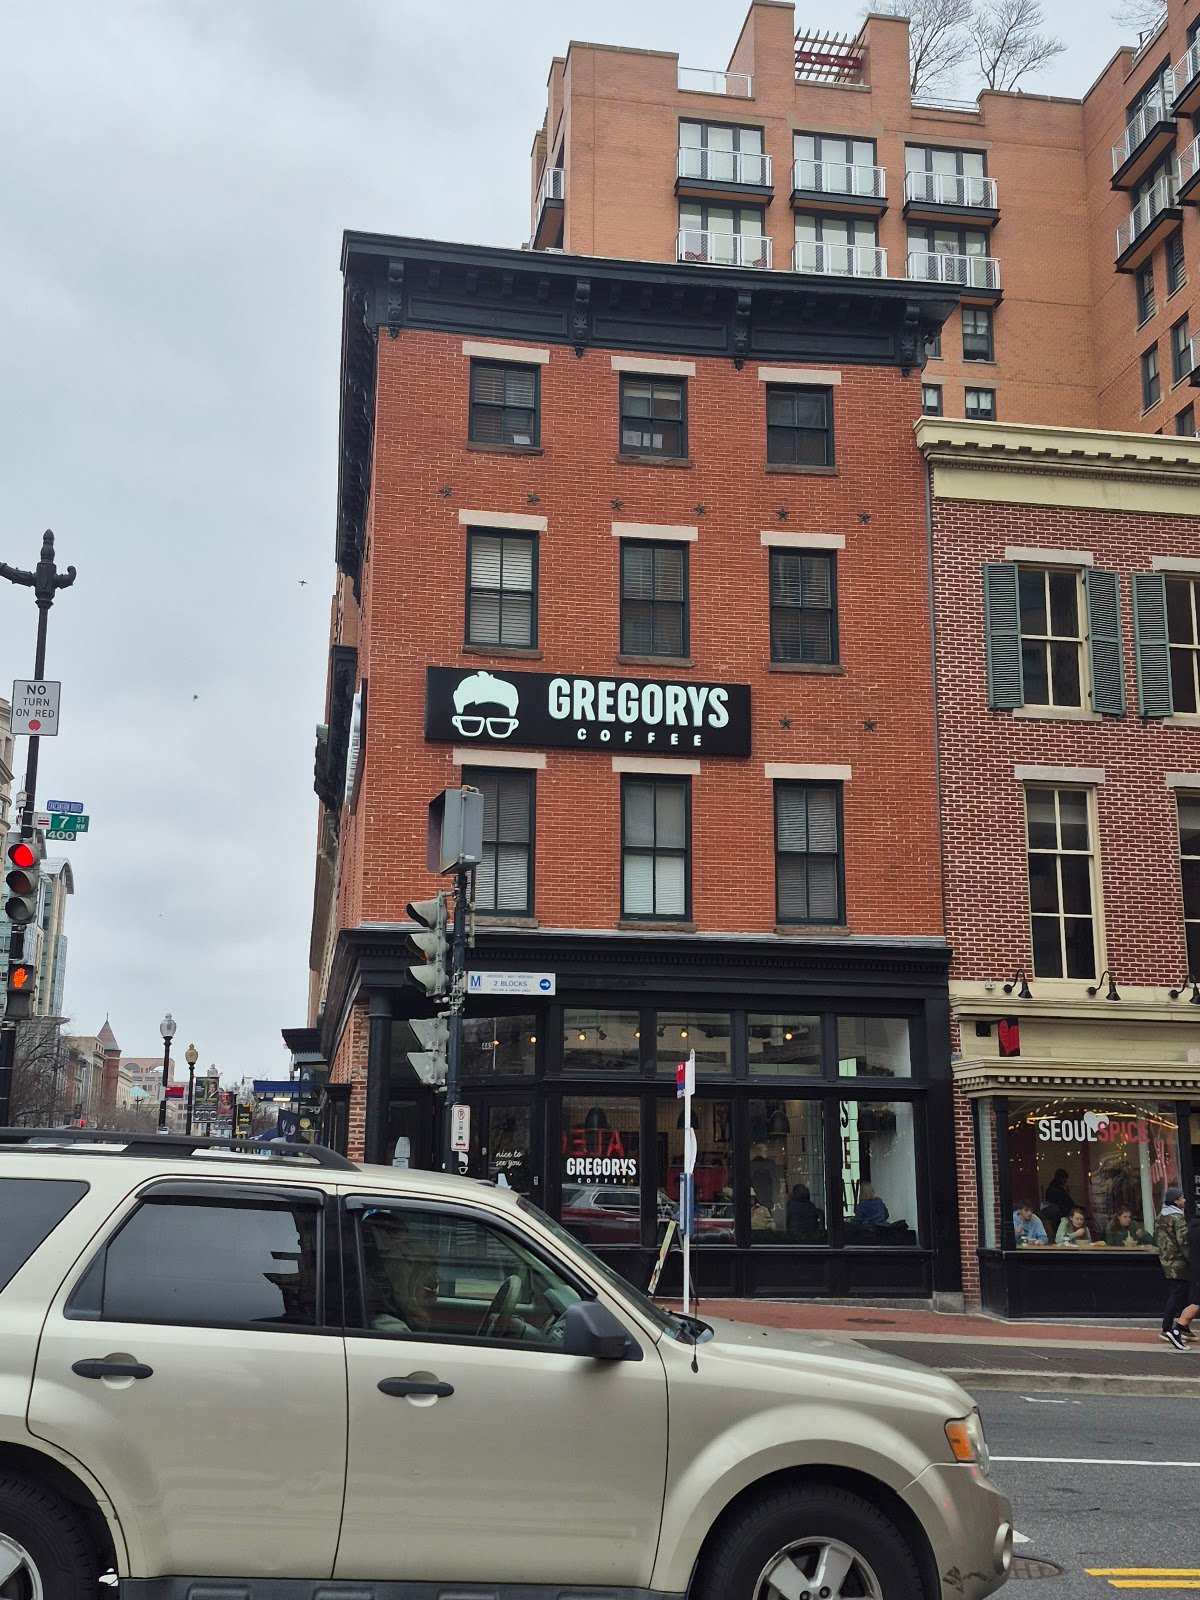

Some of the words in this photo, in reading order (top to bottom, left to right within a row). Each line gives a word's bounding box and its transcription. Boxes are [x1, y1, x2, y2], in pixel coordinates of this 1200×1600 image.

[26, 684, 47, 696] NO
[23, 697, 50, 707] TURN
[548, 677, 730, 729] GREGORYS
[15, 708, 30, 718] ON
[34, 709, 55, 718] RED
[576, 727, 702, 747] COFFEE
[59, 815, 70, 829] 7
[76, 816, 85, 824] ST
[47, 830, 75, 841] 400
[495, 1150, 512, 1158] nice
[513, 1150, 523, 1158] to
[507, 1160, 522, 1169] you
[566, 1157, 637, 1176] GREGORYS
